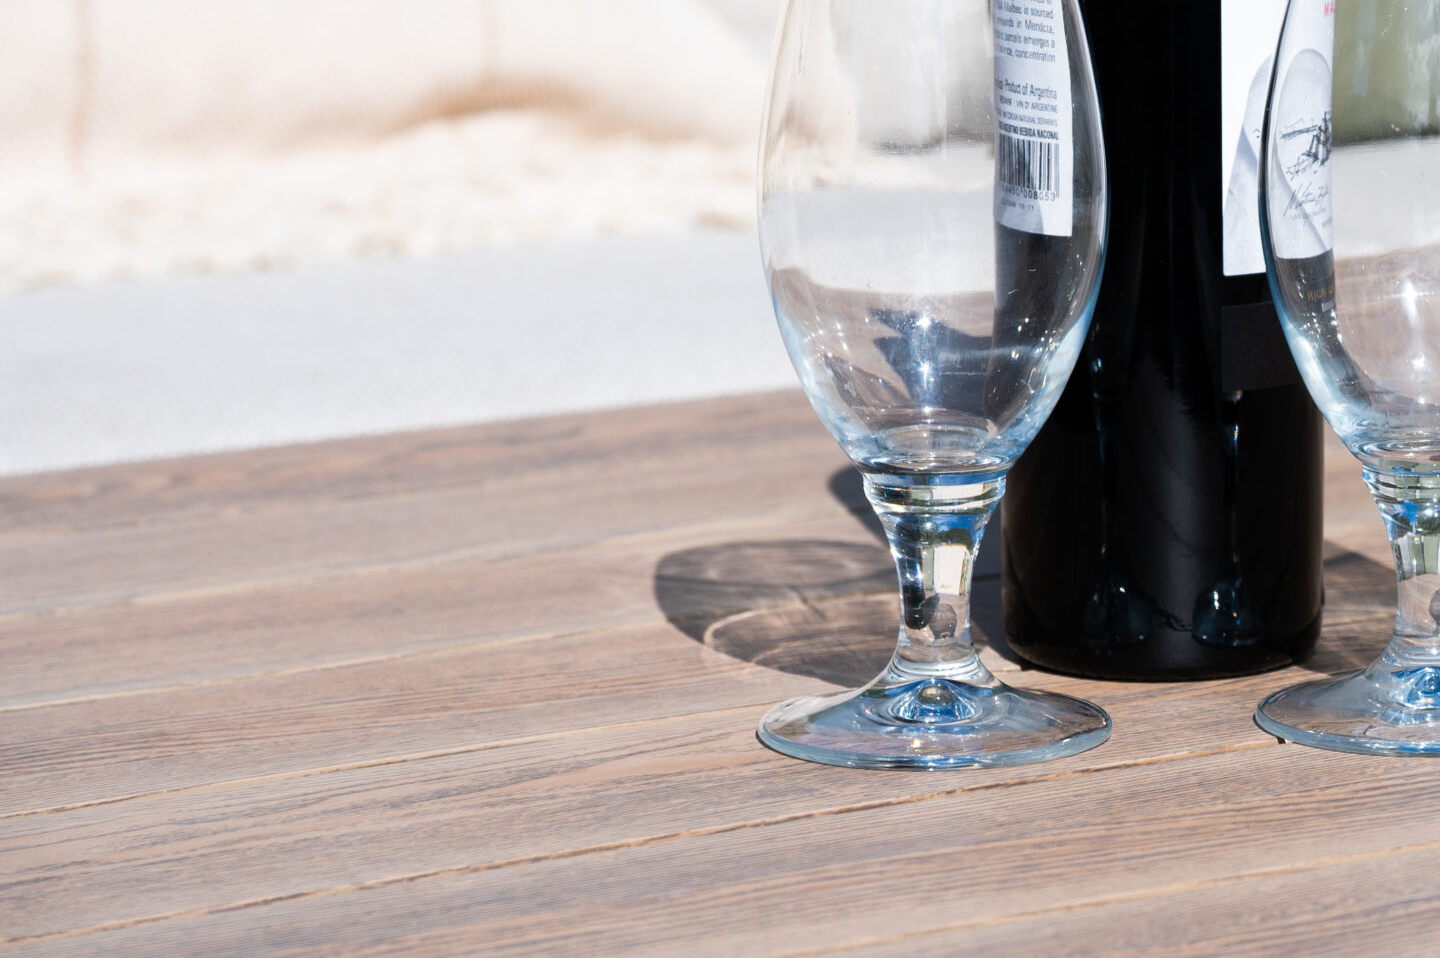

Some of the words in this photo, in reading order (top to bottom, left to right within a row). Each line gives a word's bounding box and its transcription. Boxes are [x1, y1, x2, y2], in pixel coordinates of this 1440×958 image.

[1030, 7, 1054, 19] sourced
[1023, 36, 1049, 49] emerges
[1015, 48, 1056, 63] concentration
[1022, 82, 1028, 95] of
[1029, 83, 1057, 101] Argentina
[1031, 101, 1058, 113] ARGENTINE
